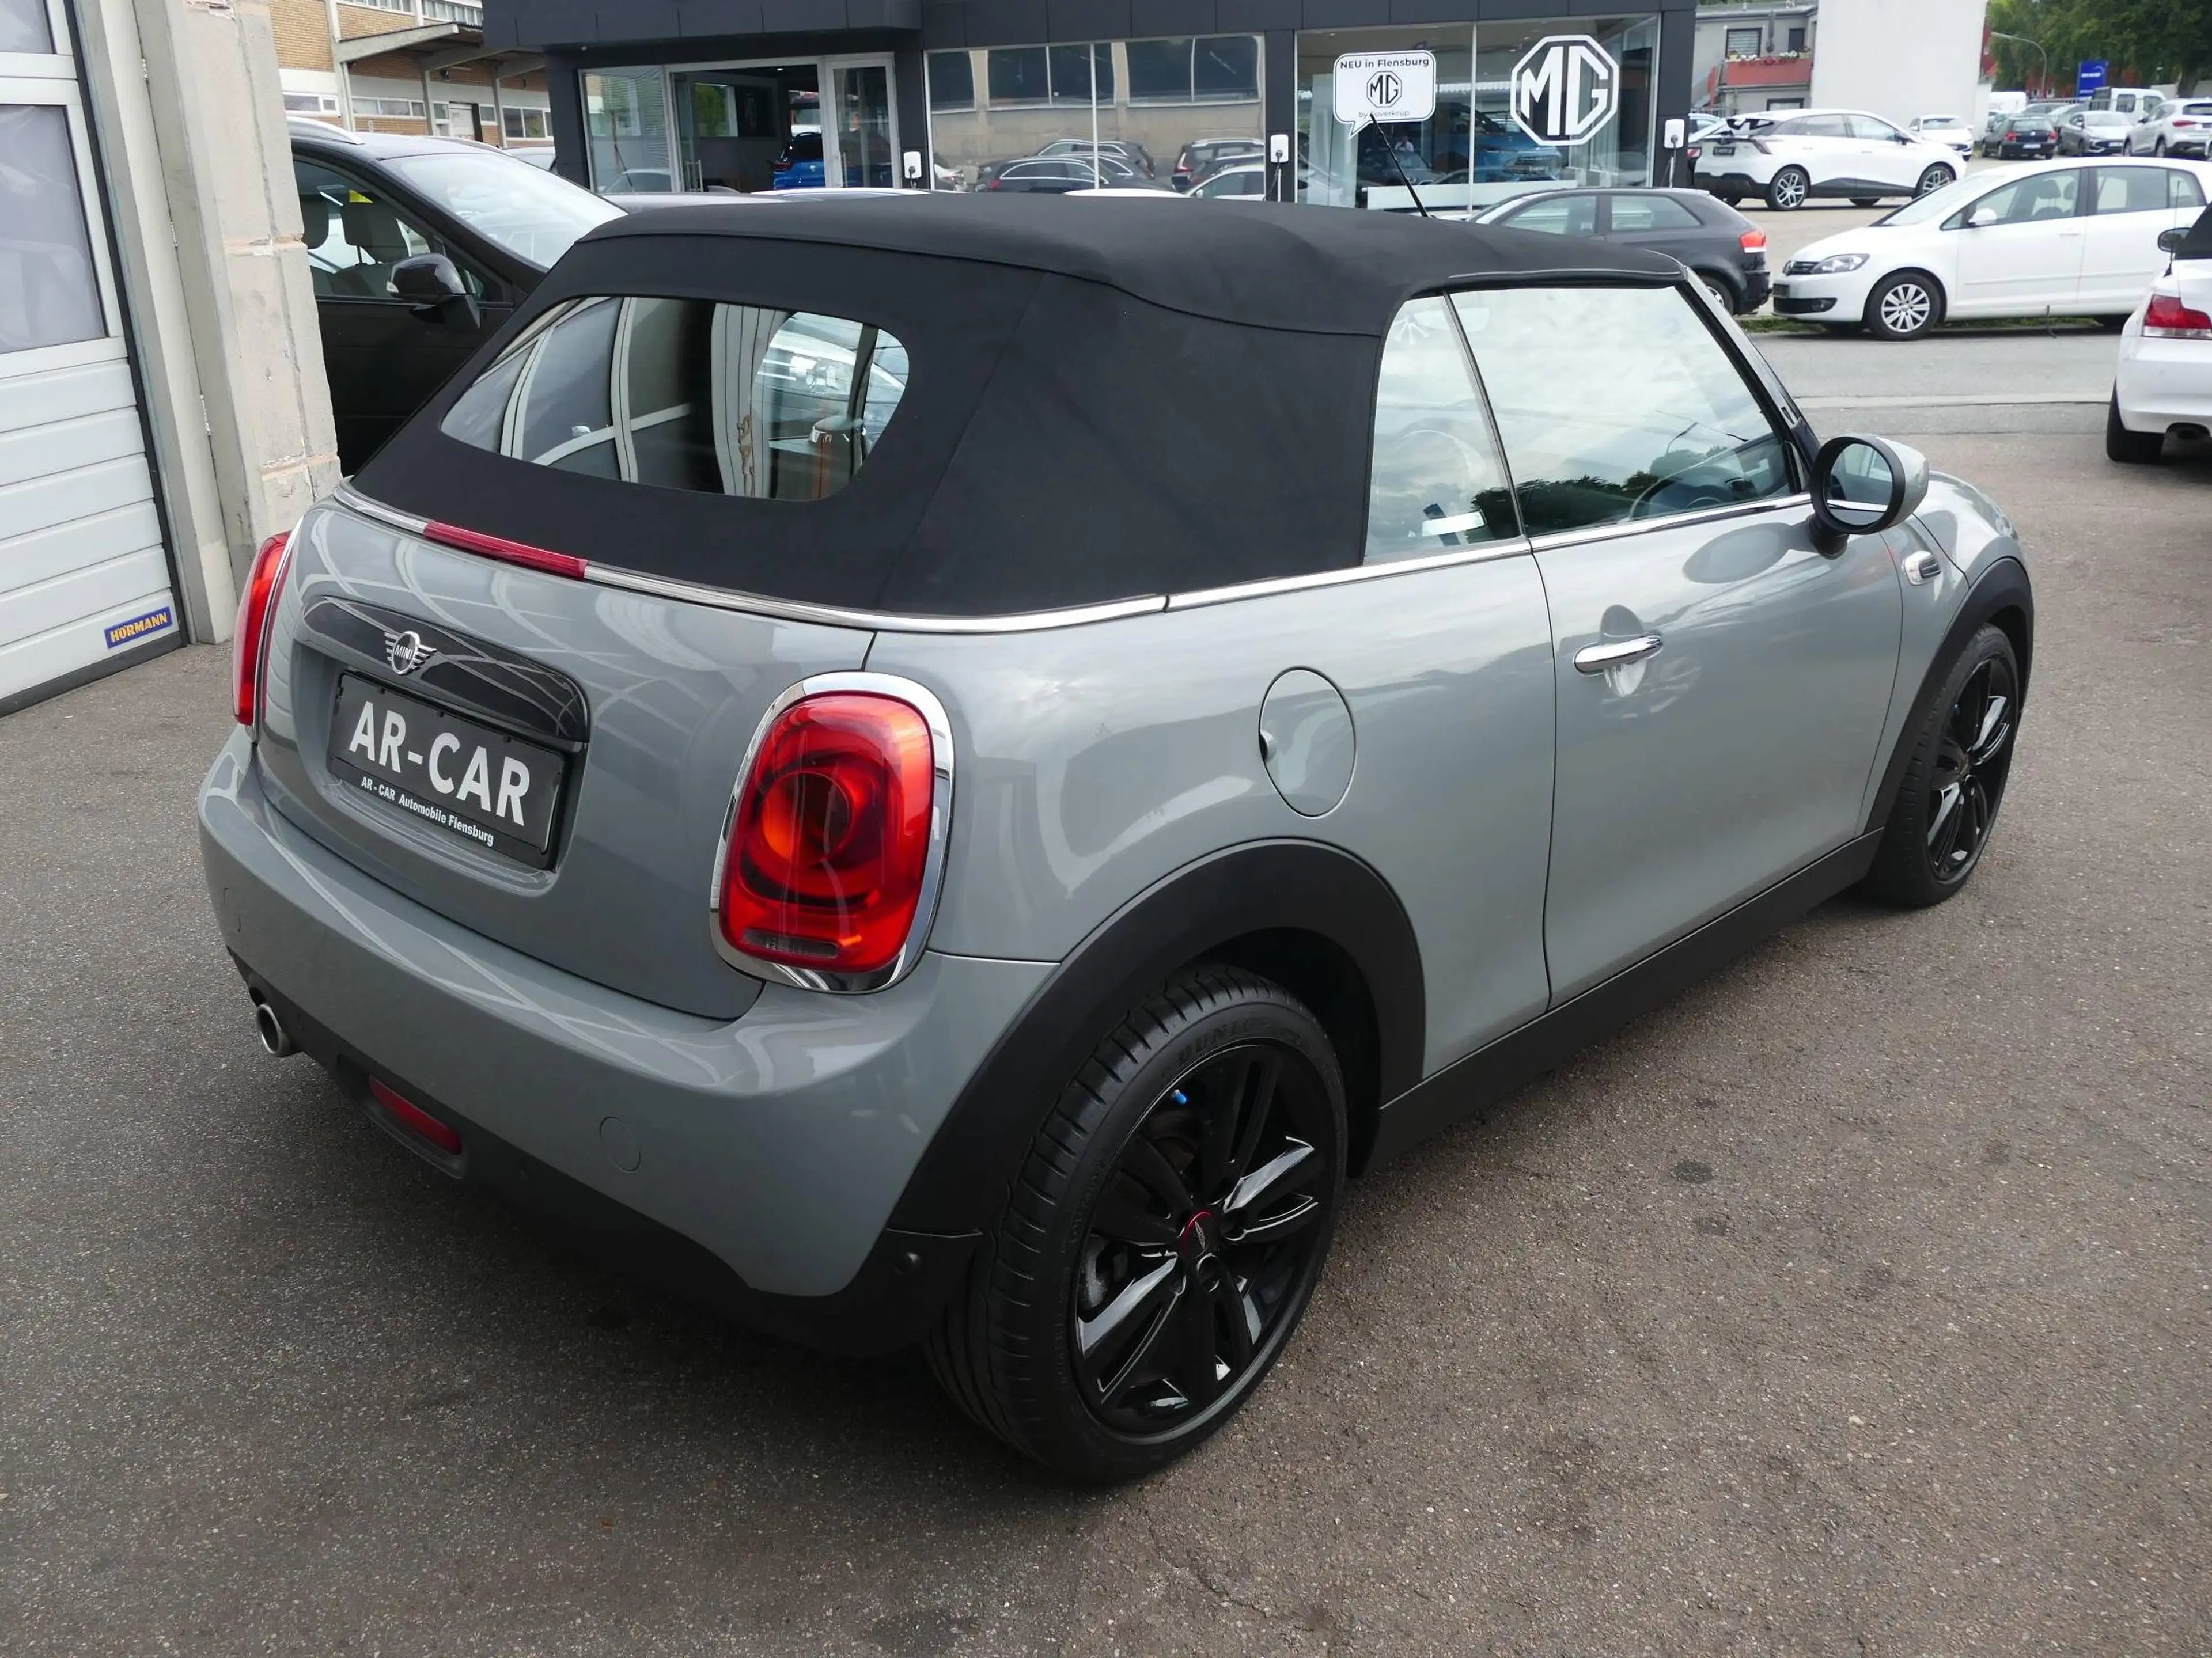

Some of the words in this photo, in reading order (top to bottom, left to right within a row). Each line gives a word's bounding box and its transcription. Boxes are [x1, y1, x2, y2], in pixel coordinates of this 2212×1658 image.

[1340, 60, 1362, 69] NEU
[1365, 59, 1374, 68] in
[1377, 59, 1429, 67] Flensburg
[1370, 75, 1399, 104] MG
[1521, 46, 1608, 135] MG
[395, 644, 414, 661] MINI
[349, 701, 530, 826] AR-CAR
[361, 777, 373, 791] AR
[378, 784, 396, 801] CAR
[399, 794, 446, 824] Automobile
[448, 815, 494, 847] Flensburg
